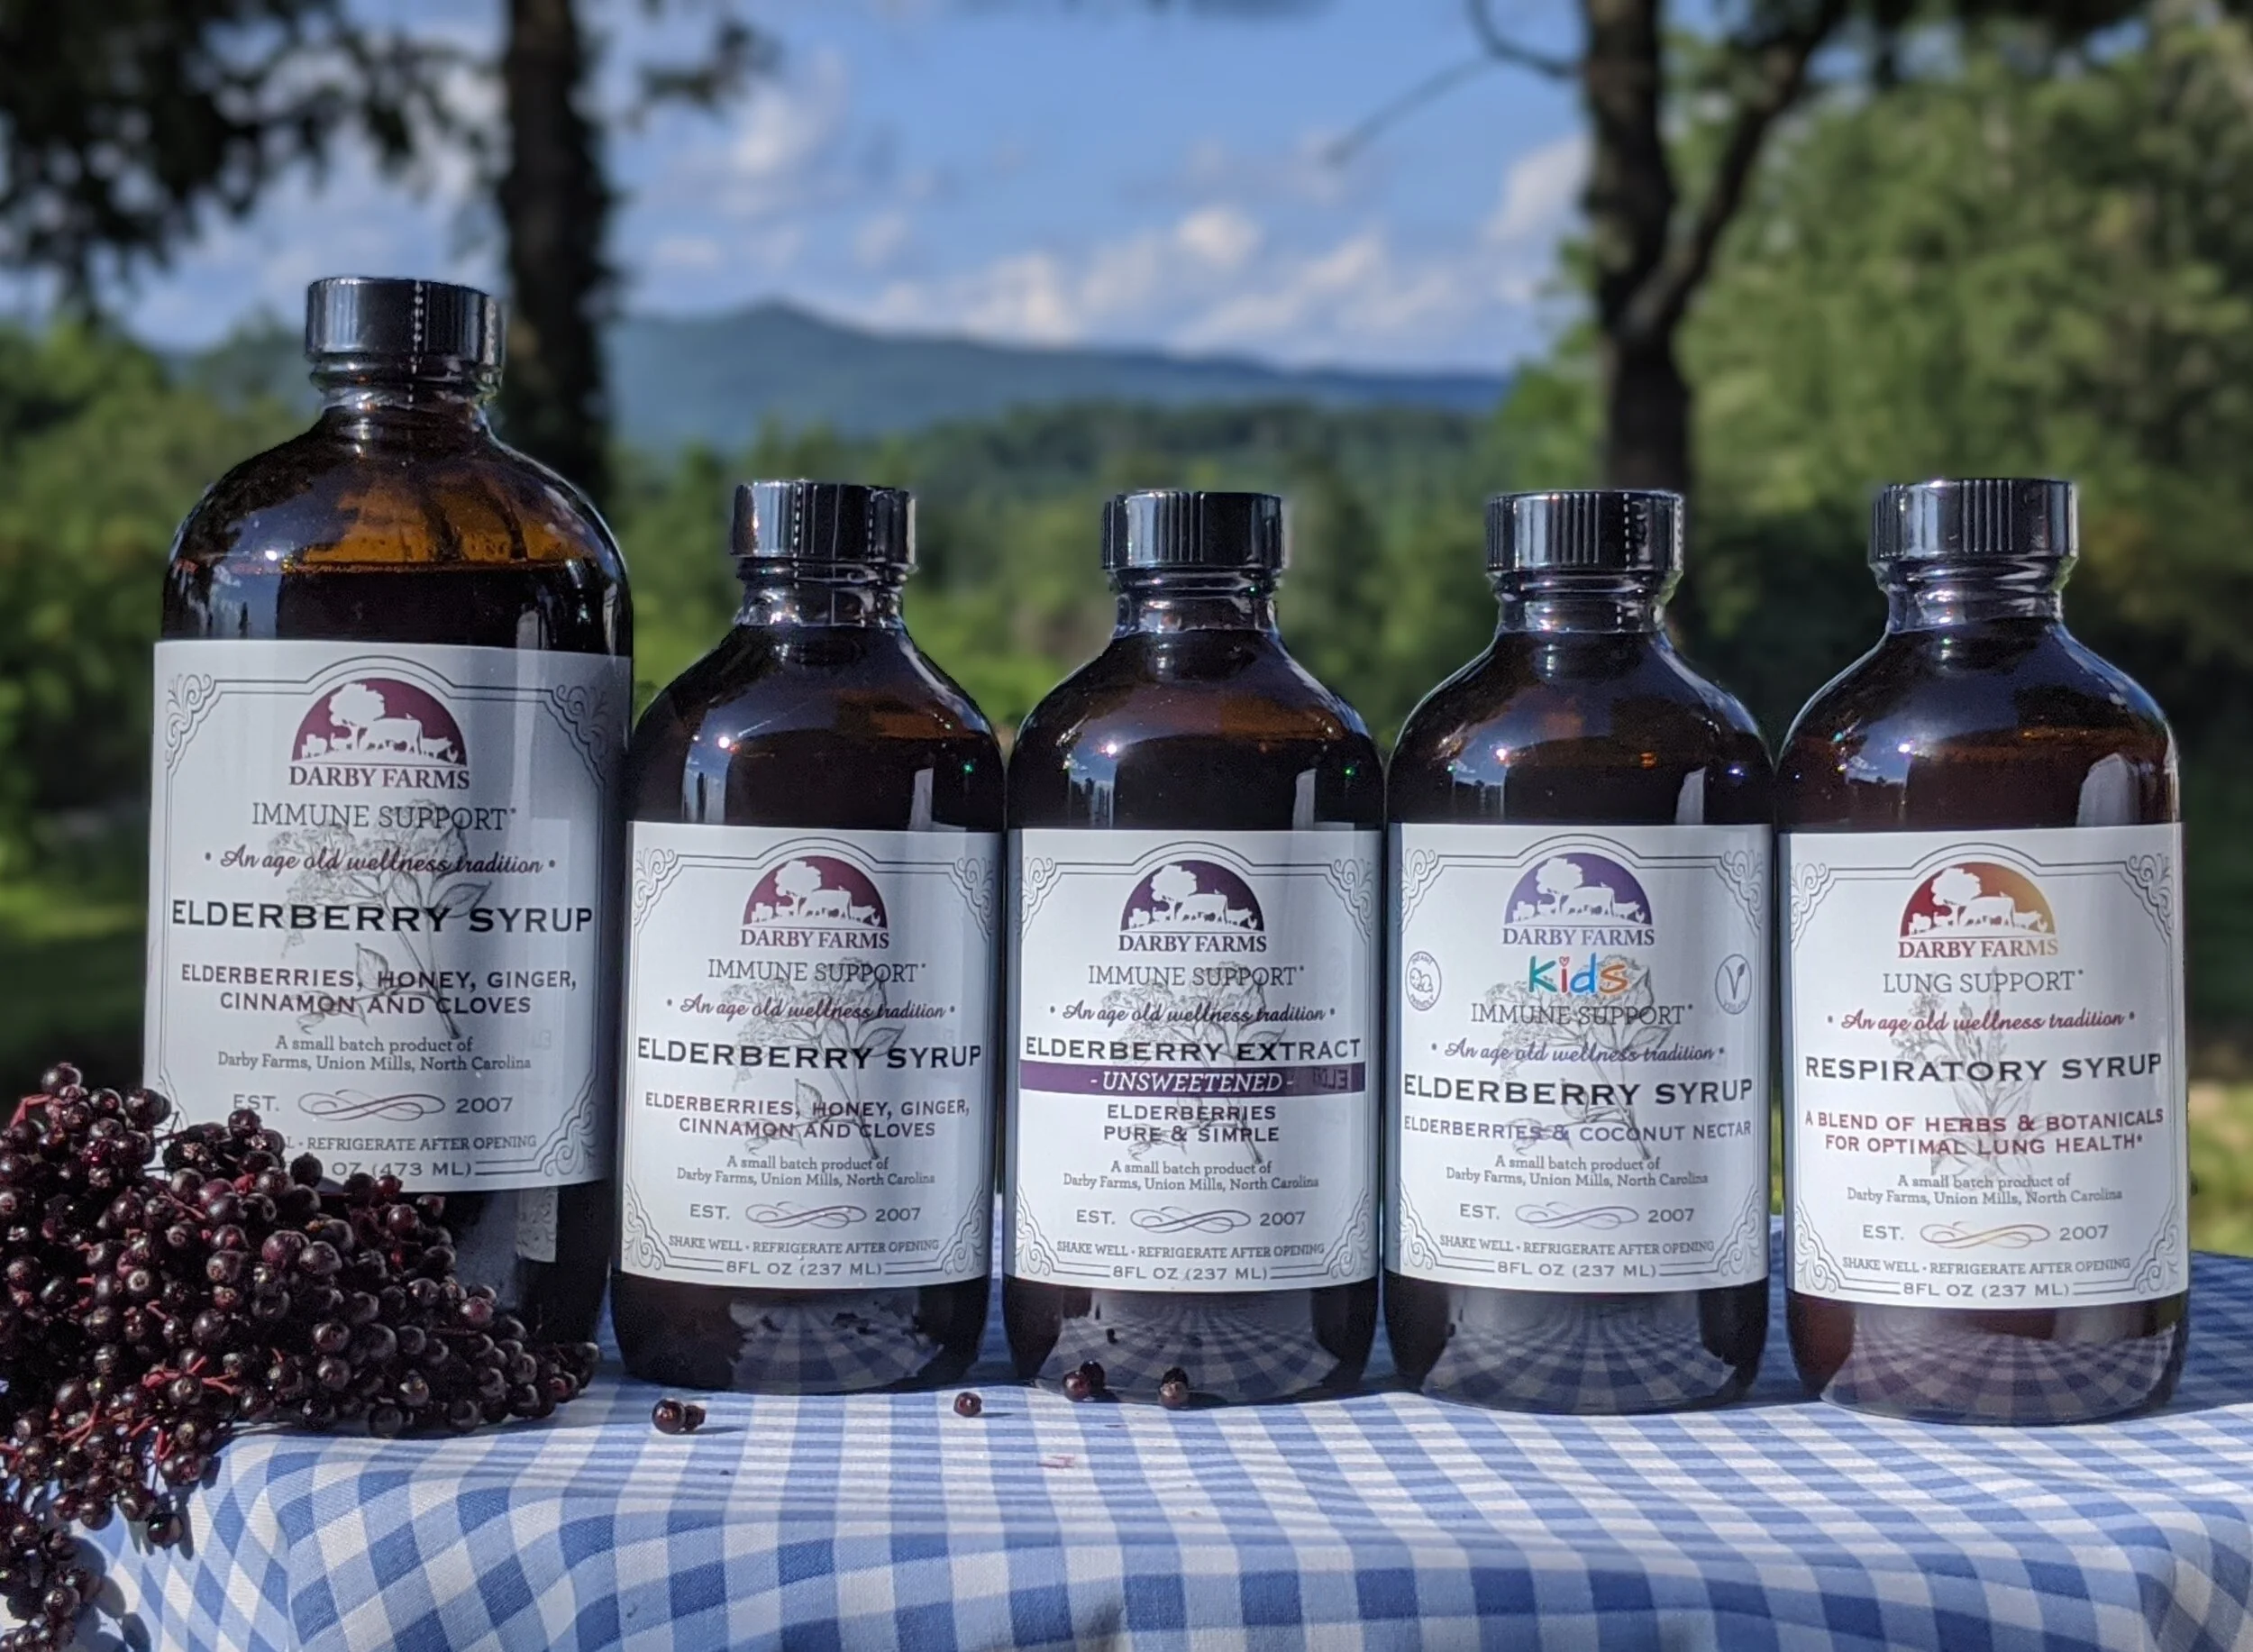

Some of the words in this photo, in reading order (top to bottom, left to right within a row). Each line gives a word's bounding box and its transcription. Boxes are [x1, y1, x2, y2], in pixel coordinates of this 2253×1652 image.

[288, 766, 377, 788] DARBY
[382, 770, 470, 789] FARMS
[252, 803, 369, 829] IMMUNE
[220, 845, 258, 868] An
[262, 852, 299, 876] age
[303, 849, 339, 871] old
[348, 851, 449, 872] wellness
[452, 851, 541, 873] tradition
[173, 900, 451, 932] ELDERBERRY
[469, 908, 593, 932] SYRUP
[741, 929, 814, 947] DARBY
[817, 931, 889, 949] FARMS
[1118, 935, 1191, 952] DARBY
[1196, 936, 1266, 953] FARMS
[1503, 927, 1577, 945] DARBY
[1582, 928, 1655, 945] FARMS
[1899, 941, 1975, 958] DARBY
[1981, 939, 2057, 955] FARMS
[182, 963, 363, 990] ELDERBERRIES,
[378, 972, 476, 993] HONEY,
[487, 970, 577, 990] GINGER,
[708, 959, 807, 981] IMMUNE
[1089, 965, 1186, 986] IMMUNE
[1884, 972, 1952, 992] LUNG
[220, 993, 356, 1014] CINNAMON
[367, 997, 424, 1014] AND
[436, 996, 531, 1014] CLOVES
[680, 994, 713, 1014] An
[716, 1000, 748, 1019] age
[753, 999, 782, 1018] old
[788, 1000, 871, 1019] wellness
[875, 999, 944, 1019] tradition
[1063, 1000, 1094, 1018] An
[1098, 1007, 1127, 1024] age
[1132, 1005, 1161, 1021] old
[1167, 1005, 1253, 1022] wellness
[1256, 1004, 1325, 1022] tradition
[1472, 1003, 1571, 1023] IMMUNE
[1841, 1010, 1874, 1028] An
[1878, 1017, 1909, 1035] age
[1914, 1013, 1947, 1030] old
[1953, 1010, 2044, 1030] wellness
[2049, 1010, 2123, 1029] tradition
[277, 1036, 288, 1050] A
[294, 1036, 333, 1052] small
[339, 1036, 384, 1052] batch
[388, 1038, 452, 1056] product
[456, 1037, 472, 1053] of
[638, 1037, 872, 1069] ELDERBERRY
[887, 1045, 981, 1069] SYRUP
[1026, 1036, 1223, 1061] ELDERBERRY
[1237, 1038, 1361, 1061] EXTRACT
[1445, 1037, 1476, 1058] An
[1481, 1047, 1510, 1065] age
[1515, 1047, 1545, 1063] old
[1552, 1045, 1640, 1063] wellness
[1644, 1044, 1713, 1063] tradition
[218, 1051, 258, 1070] Darby
[261, 1054, 310, 1071] Farms,
[317, 1055, 366, 1070] Union
[370, 1055, 415, 1072] Mills,
[420, 1055, 468, 1071] North
[472, 1056, 531, 1071] Carolina
[1806, 1056, 2047, 1082] RESPIRATORY
[2062, 1054, 2161, 1079] SYRUP
[1404, 1073, 1640, 1105] ELDERBERRY
[1656, 1080, 1752, 1105] SYRUP
[233, 1094, 279, 1110] EST.
[456, 1098, 513, 1113] 2007
[645, 1092, 800, 1118] ELDERBERRIES,
[812, 1102, 892, 1118] HONEY,
[901, 1099, 970, 1118] GINGER,
[1108, 1105, 1276, 1119] ELDERBERRIES
[680, 1118, 794, 1137] CINNAMON
[804, 1123, 850, 1138] AND
[860, 1123, 935, 1138] CLOVES
[1404, 1117, 1541, 1140] ELDERBERRIES
[1553, 1127, 1568, 1141] &
[1580, 1127, 1684, 1142] COCONUT
[1693, 1122, 1751, 1139] NECTAR
[1805, 1110, 1813, 1126] A
[1819, 1113, 1876, 1129] BLEND
[1886, 1117, 1914, 1130] OF
[1926, 1118, 2006, 1132] HERBS
[2019, 1117, 2035, 1131] &
[2047, 1109, 2163, 1130] BOTANICALS
[308, 1136, 415, 1152] REFRIGERATE
[420, 1136, 469, 1150] AFTER
[473, 1135, 536, 1149] OPENING
[1104, 1127, 1162, 1141] PURE
[1172, 1127, 1187, 1141] &
[1198, 1127, 1279, 1141] SIMPLE
[1826, 1136, 1859, 1151] FOR
[1867, 1138, 1966, 1155] OPTIMAL
[1977, 1139, 2045, 1154] LUNG
[371, 1163, 422, 1177] (473
[433, 1162, 472, 1176] ML)
[1495, 1155, 1505, 1167] A
[1510, 1156, 1545, 1170] small
[1548, 1157, 1587, 1170] batch
[1591, 1157, 1641, 1173] product
[1645, 1156, 1660, 1170] of
[677, 1168, 712, 1182] Darby
[716, 1171, 756, 1187] Farms,
[762, 1173, 802, 1185] Union
[807, 1173, 843, 1189] Mills,
[847, 1173, 884, 1186] North
[888, 1173, 935, 1185] Carolina
[690, 1205, 730, 1219] EST.
[875, 1208, 921, 1221] 2007
[1076, 1209, 1115, 1224] EST.
[1260, 1211, 1305, 1226] 2007
[1460, 1205, 1500, 1219] EST.
[1648, 1209, 1694, 1223] 2007
[1863, 1225, 1903, 1239] EST.
[2059, 1225, 2108, 1240] 2007
[669, 1236, 706, 1249] SHAKE
[708, 1239, 742, 1252] WELL
[753, 1241, 843, 1255] REFRIGERATE
[846, 1242, 886, 1254] AFTER
[889, 1240, 939, 1253] OPENING
[1057, 1241, 1093, 1254] SHAKE
[1096, 1244, 1128, 1255] WELL
[1138, 1246, 1227, 1258] REFRIGERATE
[1231, 1246, 1271, 1258] AFTER
[1273, 1244, 1324, 1255] OPENING
[767, 1263, 792, 1275] OZ
[800, 1263, 840, 1277] (237
[848, 1263, 882, 1275] ML)
[1154, 1267, 1179, 1280] OZ
[1186, 1267, 1227, 1281] (237
[1236, 1267, 1268, 1280] ML)
[1538, 1263, 1564, 1275] OZ
[1573, 1264, 1614, 1277] (237
[1623, 1264, 1656, 1277] ML)
[1947, 1284, 1974, 1297] OZ
[1982, 1284, 2025, 1299] (237
[2035, 1283, 2069, 1297] ML)
